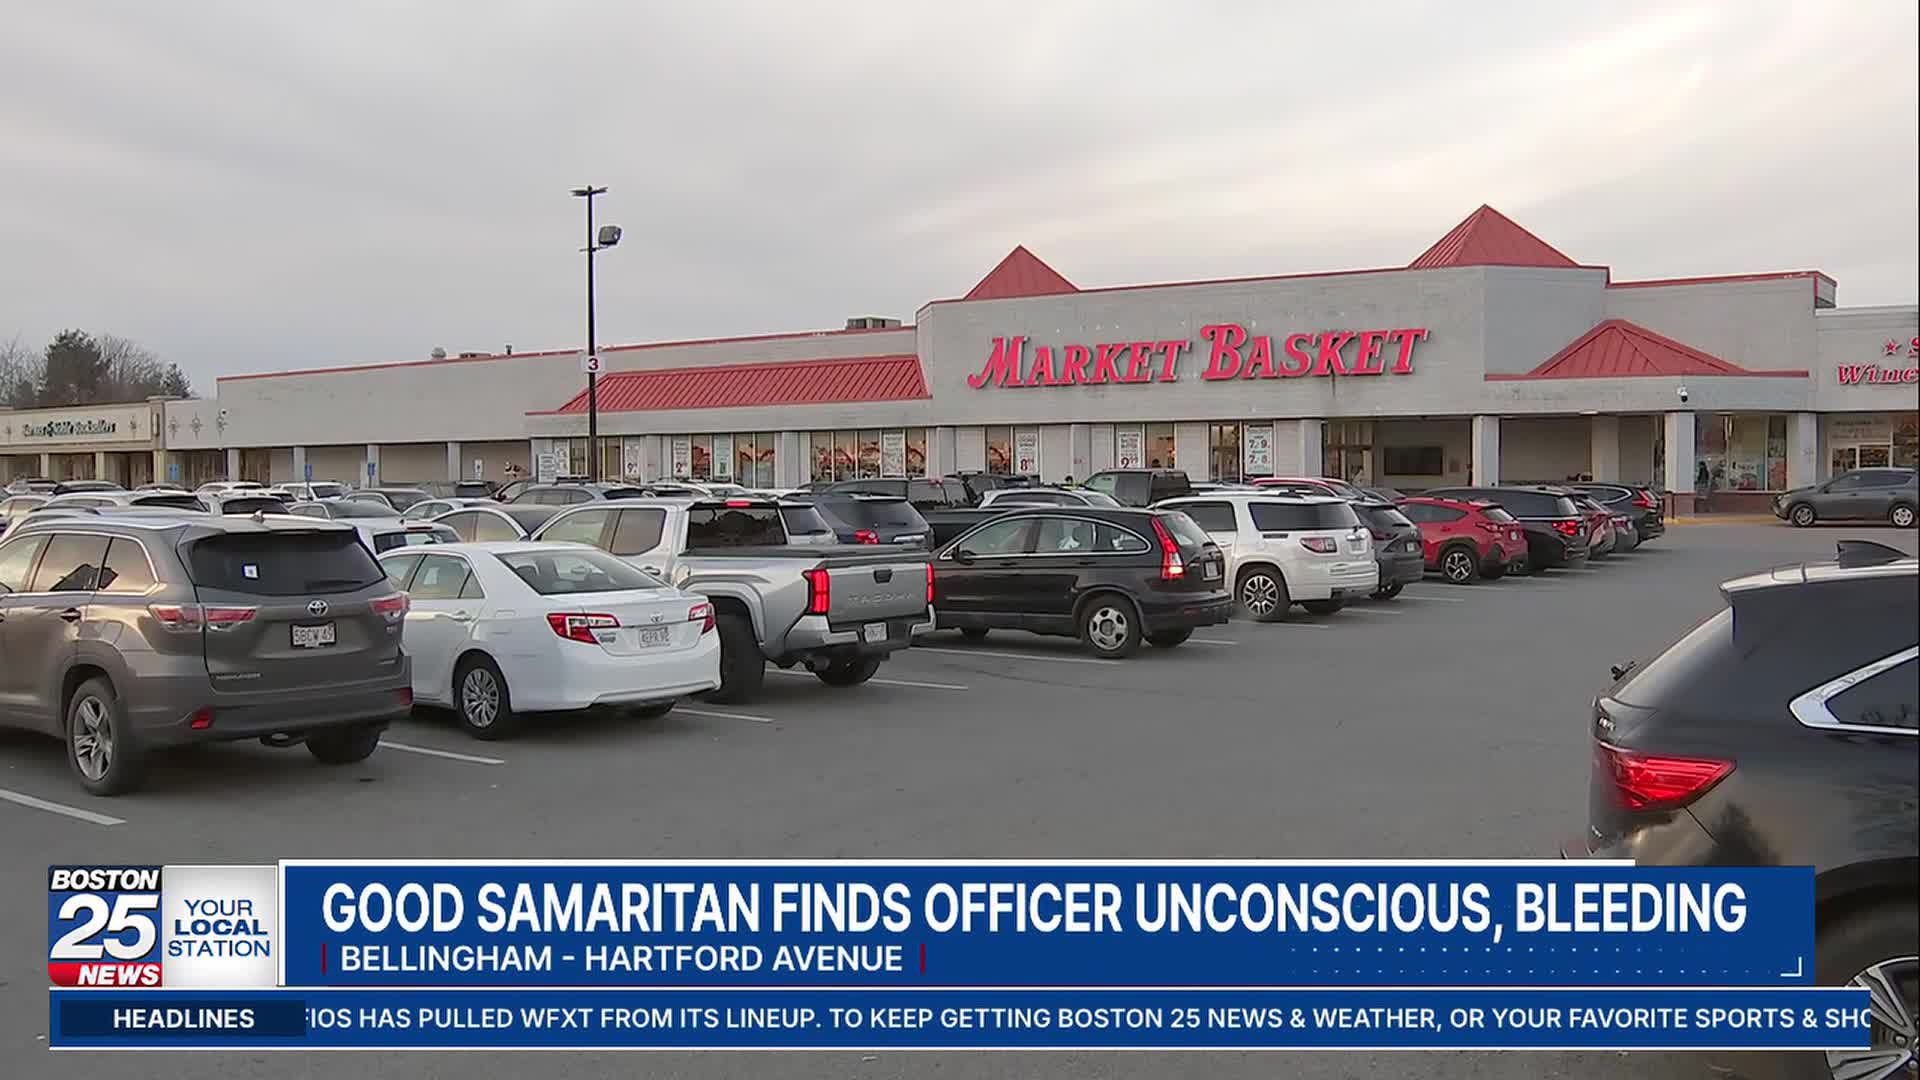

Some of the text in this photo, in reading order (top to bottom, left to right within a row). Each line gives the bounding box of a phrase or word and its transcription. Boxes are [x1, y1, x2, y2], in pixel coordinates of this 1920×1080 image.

[588, 357, 599, 371] 3
[967, 323, 1429, 390] MARKET BASKET
